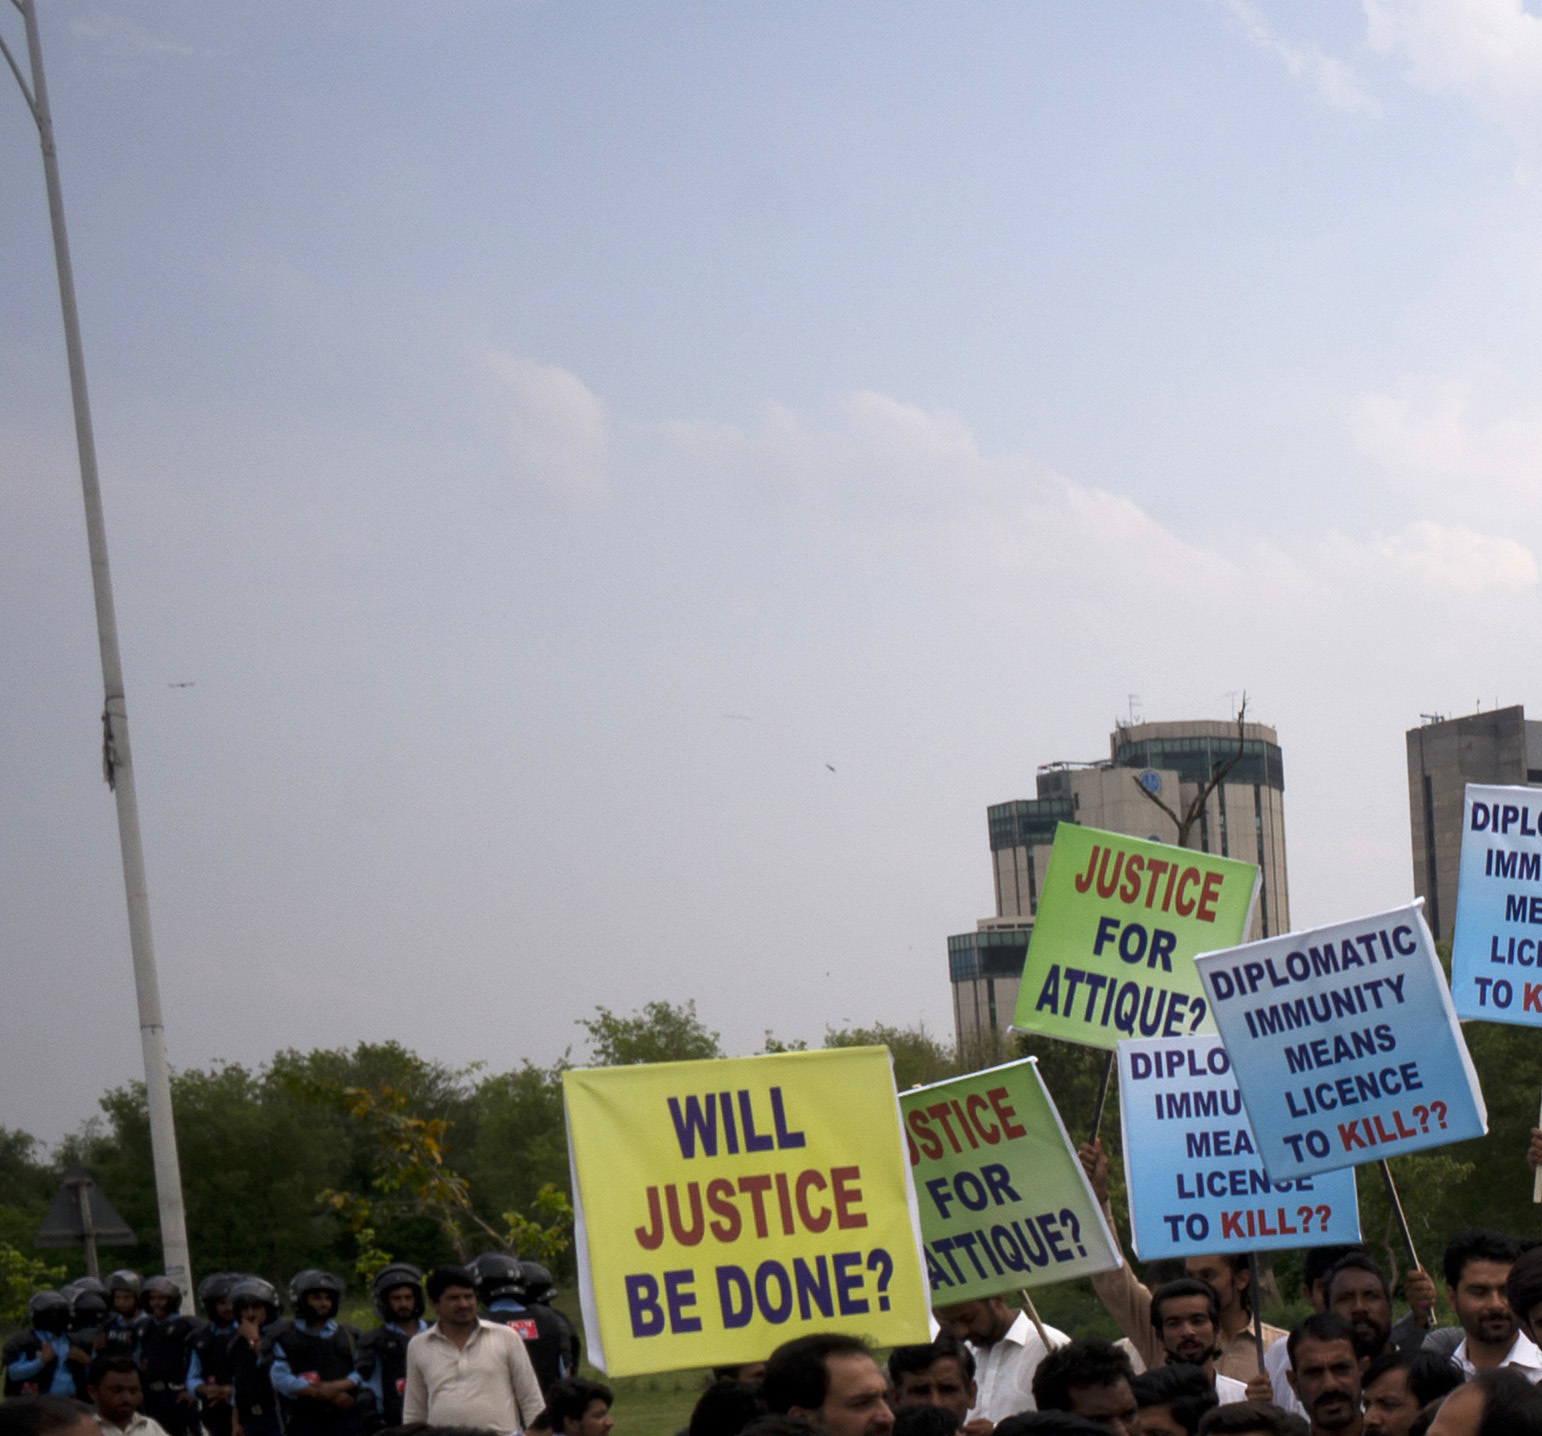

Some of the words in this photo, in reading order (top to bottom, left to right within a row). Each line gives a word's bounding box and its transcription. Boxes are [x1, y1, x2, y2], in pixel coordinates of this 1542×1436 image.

[1075, 845, 1224, 923] JUSTICE
[1093, 916, 1177, 973] FOR
[1209, 925, 1418, 1001] DIPLOMATIC
[1035, 964, 1207, 1039] ATTIQUE?
[1243, 974, 1406, 1040] IMMUNITY
[1474, 977, 1512, 1008] TO
[1285, 1024, 1397, 1075] MEANS
[667, 1087, 806, 1159] WILL
[1284, 1062, 1423, 1119] LICENCE
[905, 1087, 1027, 1167] STICE
[1186, 1130, 1254, 1158] MEA
[1283, 1129, 1330, 1163] TO
[1337, 1101, 1448, 1152] KILL??
[634, 1166, 868, 1250] JUSTICE
[925, 1163, 1022, 1219] FOR
[1163, 1213, 1209, 1242] TO
[1221, 1205, 1331, 1239] KILL??
[923, 1208, 1087, 1290] ATTIQUE?
[625, 1269, 702, 1338] BE
[716, 1248, 893, 1329] DONE?
